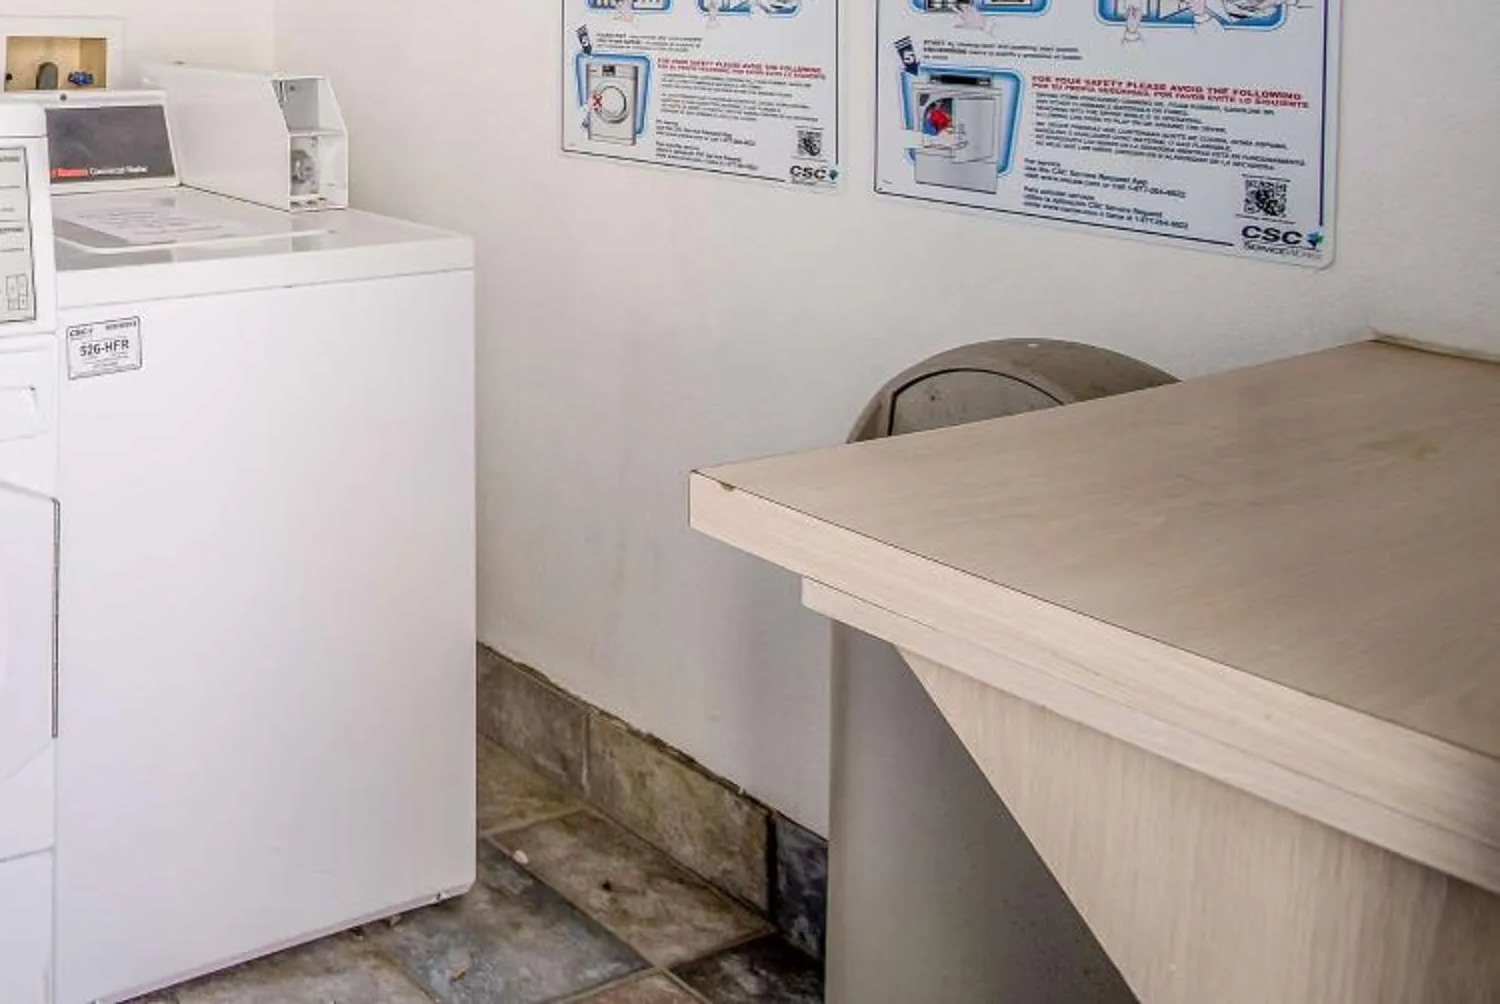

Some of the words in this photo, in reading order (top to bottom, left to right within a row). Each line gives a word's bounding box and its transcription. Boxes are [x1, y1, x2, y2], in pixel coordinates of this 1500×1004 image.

[1085, 78, 1122, 87] SAFETY
[1127, 81, 1166, 90] PLEASE
[1170, 84, 1202, 93] AVOID
[1207, 87, 1228, 95] THE
[1233, 89, 1300, 100] FOLLOWING
[790, 165, 828, 181] CSC
[1241, 224, 1304, 246] CSC
[80, 339, 129, 357] 526-HFR
